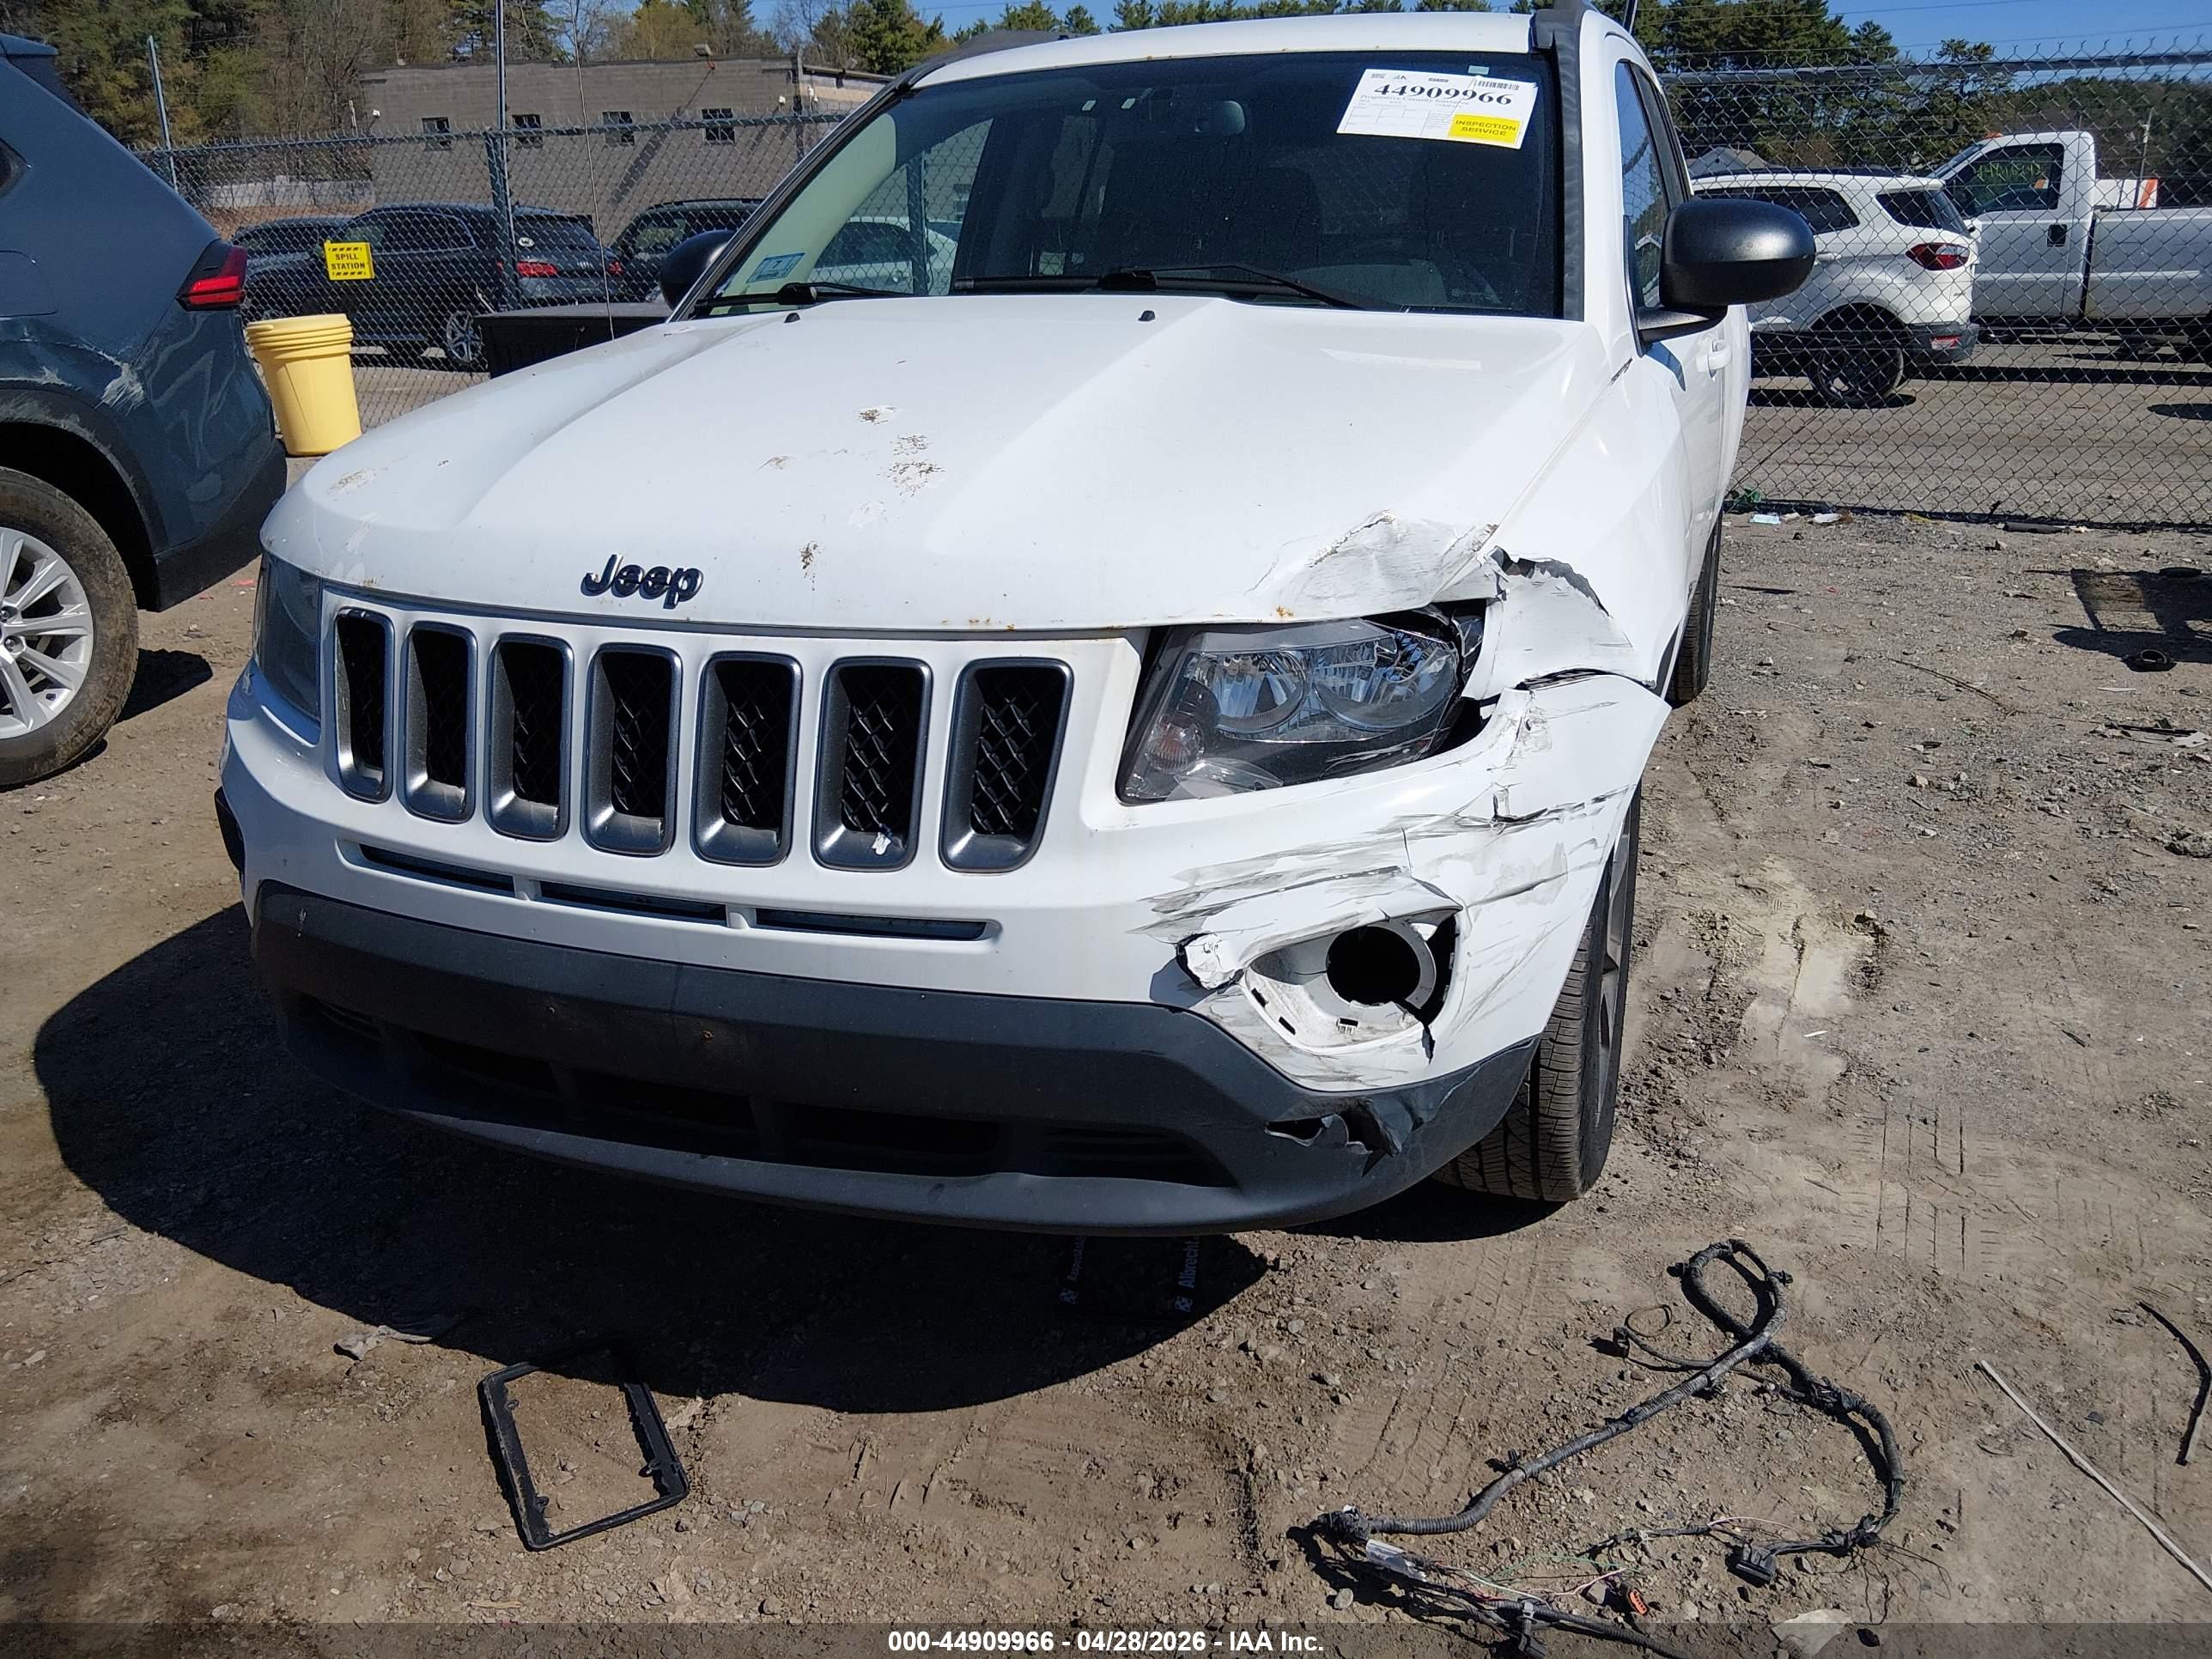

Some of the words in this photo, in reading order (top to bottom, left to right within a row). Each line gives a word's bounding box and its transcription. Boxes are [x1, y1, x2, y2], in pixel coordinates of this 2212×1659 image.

[1374, 84, 1514, 105] 44909966
[1455, 119, 1516, 131] INSPECTION
[1461, 126, 1507, 136] SERVICE
[580, 554, 703, 609] Jeep
